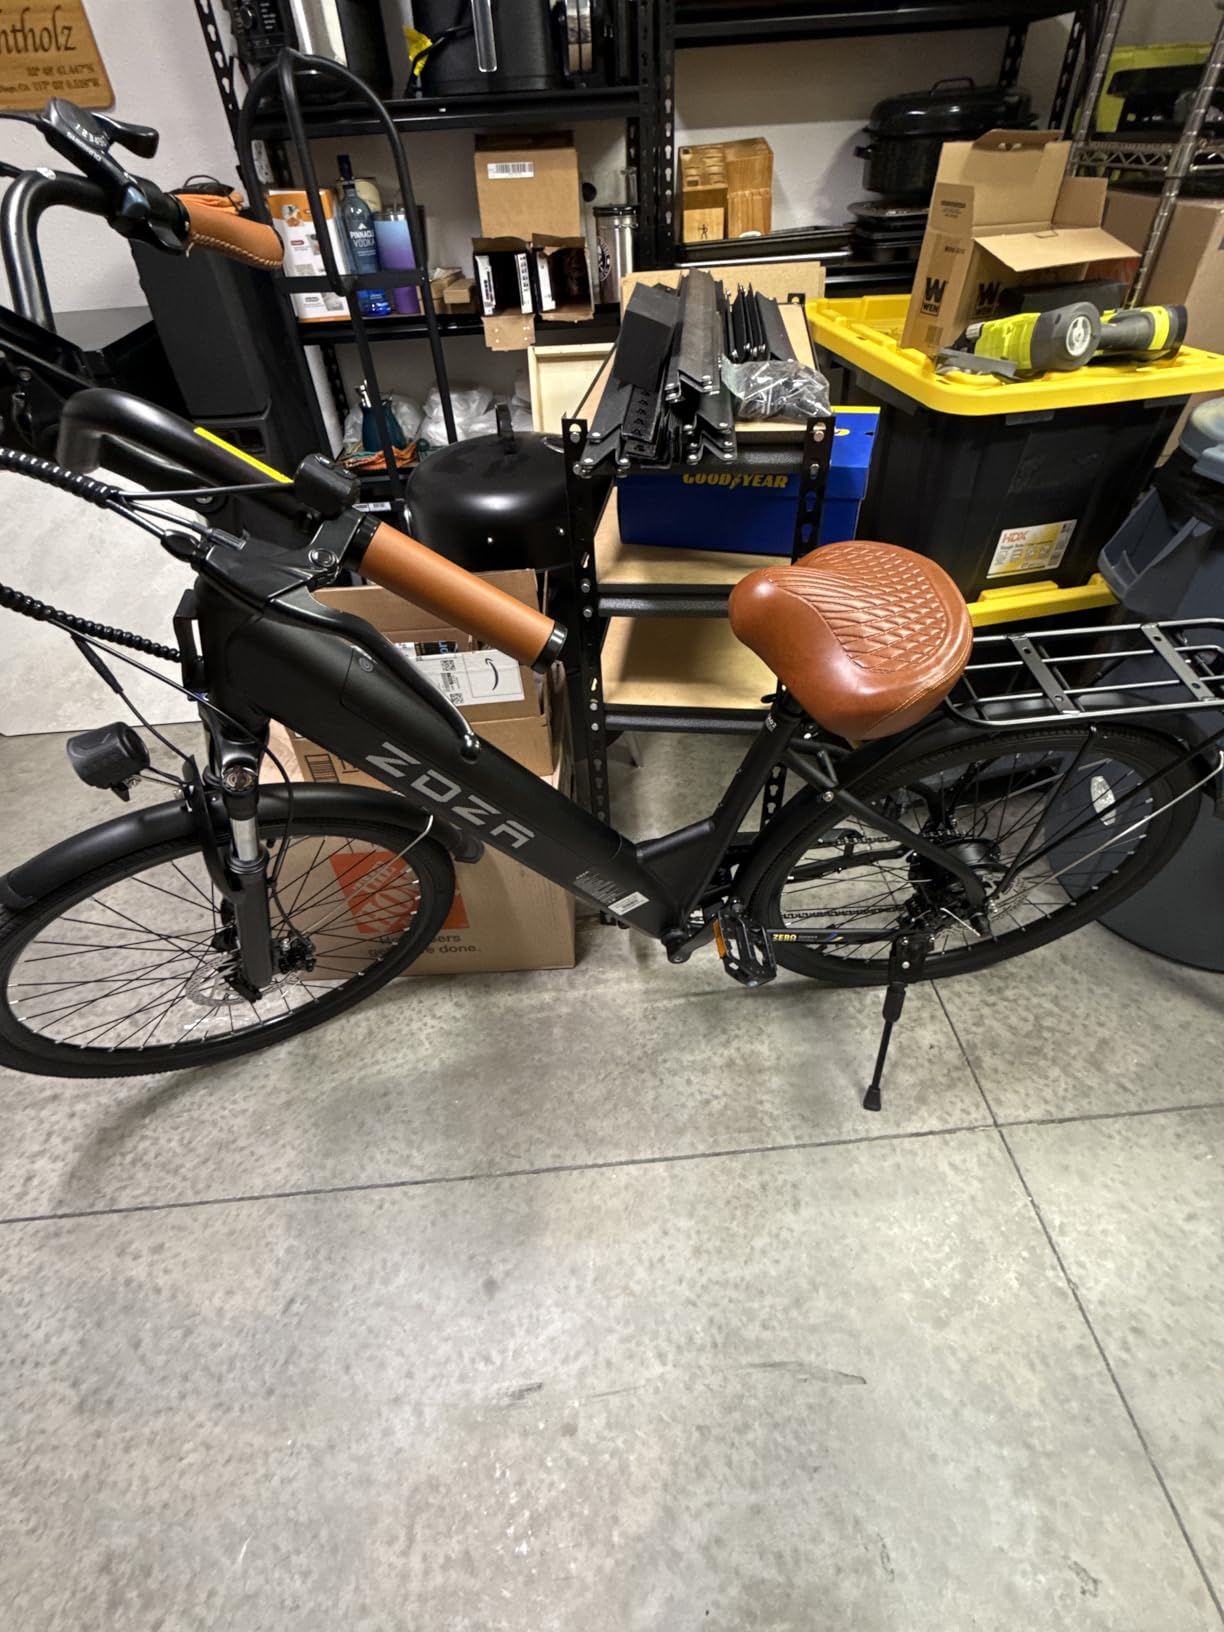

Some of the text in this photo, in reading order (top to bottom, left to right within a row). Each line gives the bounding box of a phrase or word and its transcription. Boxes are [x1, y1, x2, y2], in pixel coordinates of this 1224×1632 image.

[349, 230, 375, 239] PINNACL
[353, 238, 376, 247] VODKA
[1001, 530, 1030, 545] HDX
[772, 933, 797, 942] ZERO
